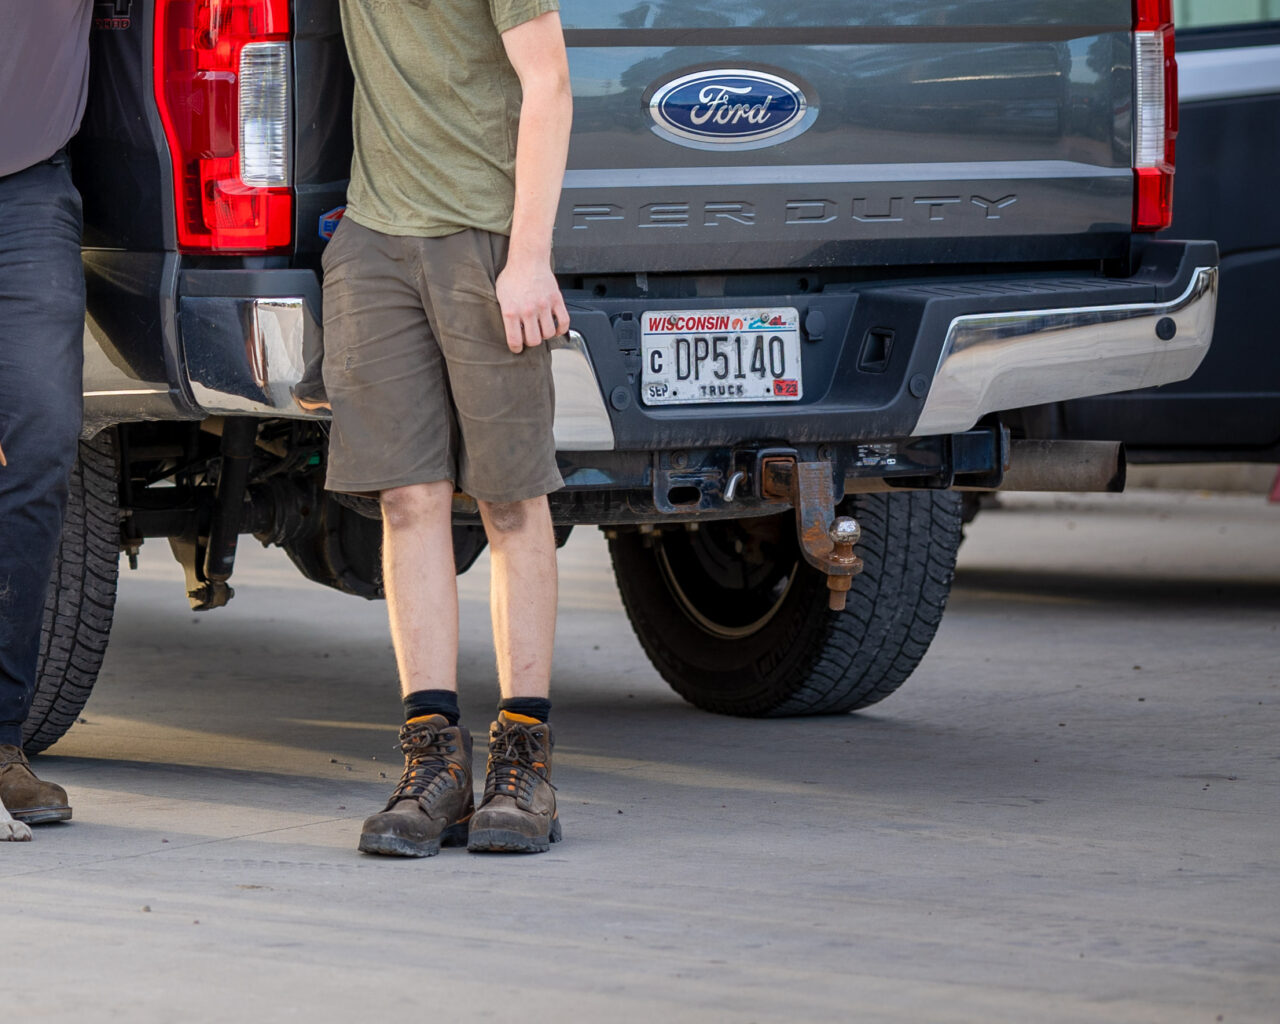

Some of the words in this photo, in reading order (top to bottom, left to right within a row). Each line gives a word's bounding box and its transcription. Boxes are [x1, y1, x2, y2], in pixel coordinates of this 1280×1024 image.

[690, 85, 772, 125] Ford
[571, 202, 756, 230] PER
[785, 194, 1018, 225] DUTY
[649, 316, 730, 331] WISCONSIN
[650, 349, 663, 374] C
[676, 335, 786, 381] DP5140
[649, 384, 668, 398] SEP
[701, 384, 744, 396] TRUCK
